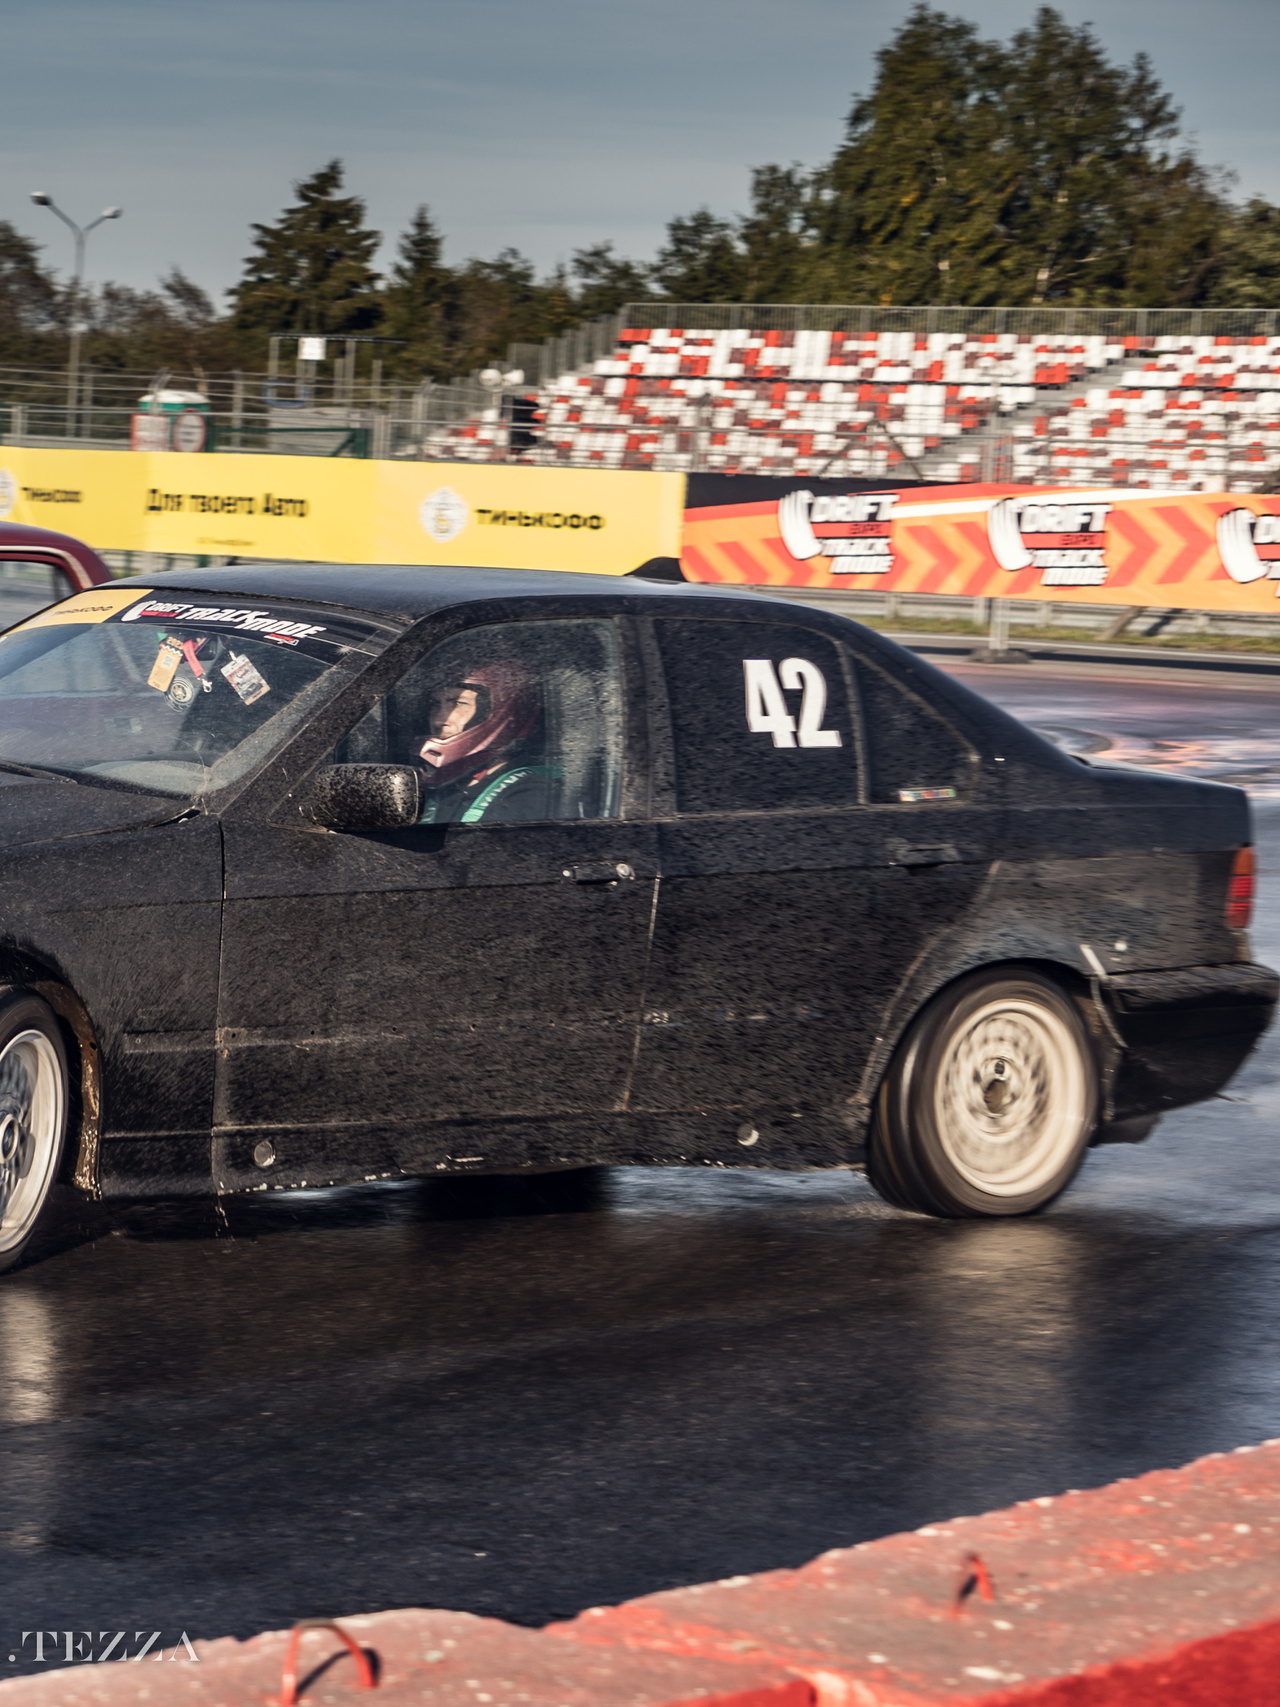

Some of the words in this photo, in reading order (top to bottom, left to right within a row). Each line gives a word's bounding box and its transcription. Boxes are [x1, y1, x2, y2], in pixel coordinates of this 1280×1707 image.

[144, 488, 183, 516] Для
[189, 493, 257, 515] твоего
[260, 492, 311, 518] Авто
[810, 494, 900, 522] DRIFT
[1020, 504, 1114, 533] DRIFT
[145, 602, 195, 613] DRIFT
[742, 657, 843, 748] 42
